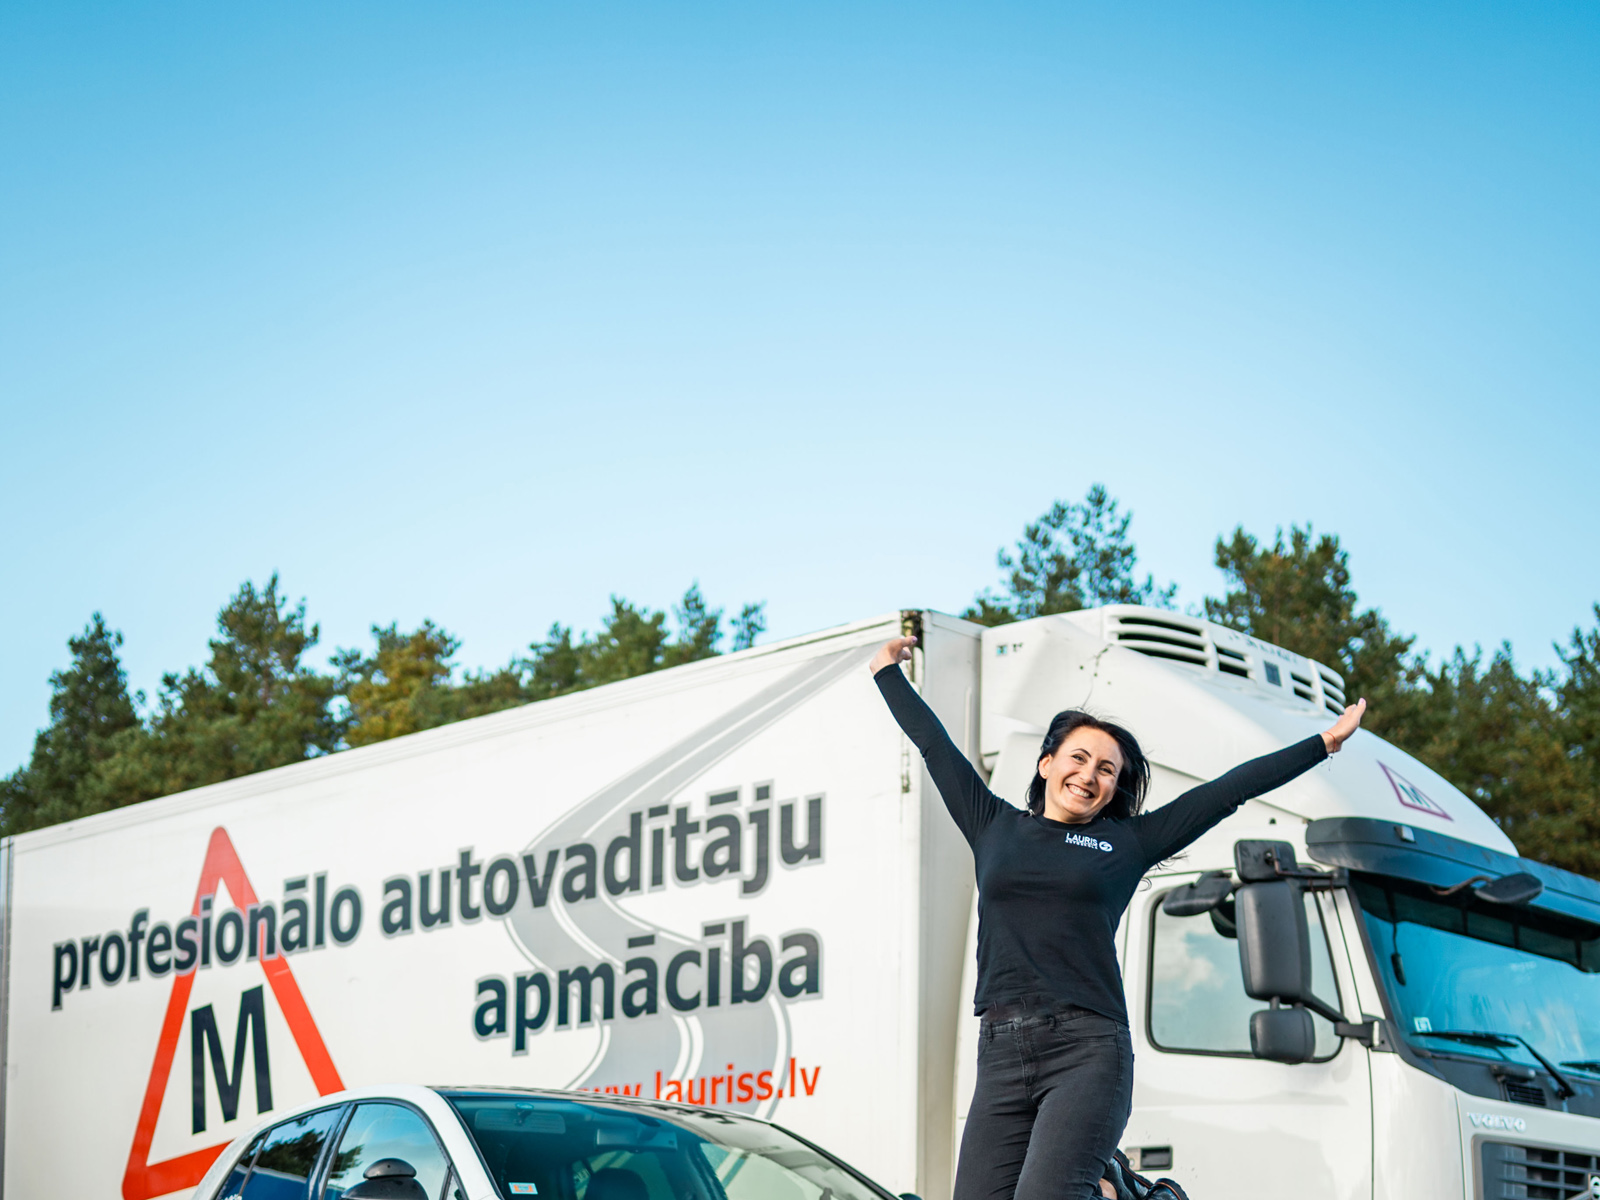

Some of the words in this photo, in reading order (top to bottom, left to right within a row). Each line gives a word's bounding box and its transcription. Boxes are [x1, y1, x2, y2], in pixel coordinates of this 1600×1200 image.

[1066, 832, 1098, 845] LAURIS
[52, 873, 362, 1010] profesionālo
[381, 781, 825, 937] autovadītāju
[474, 917, 823, 1056] apmācība
[191, 984, 273, 1135] M
[577, 1057, 821, 1106] lauriss.lv
[1466, 1112, 1527, 1133] VOLVO
